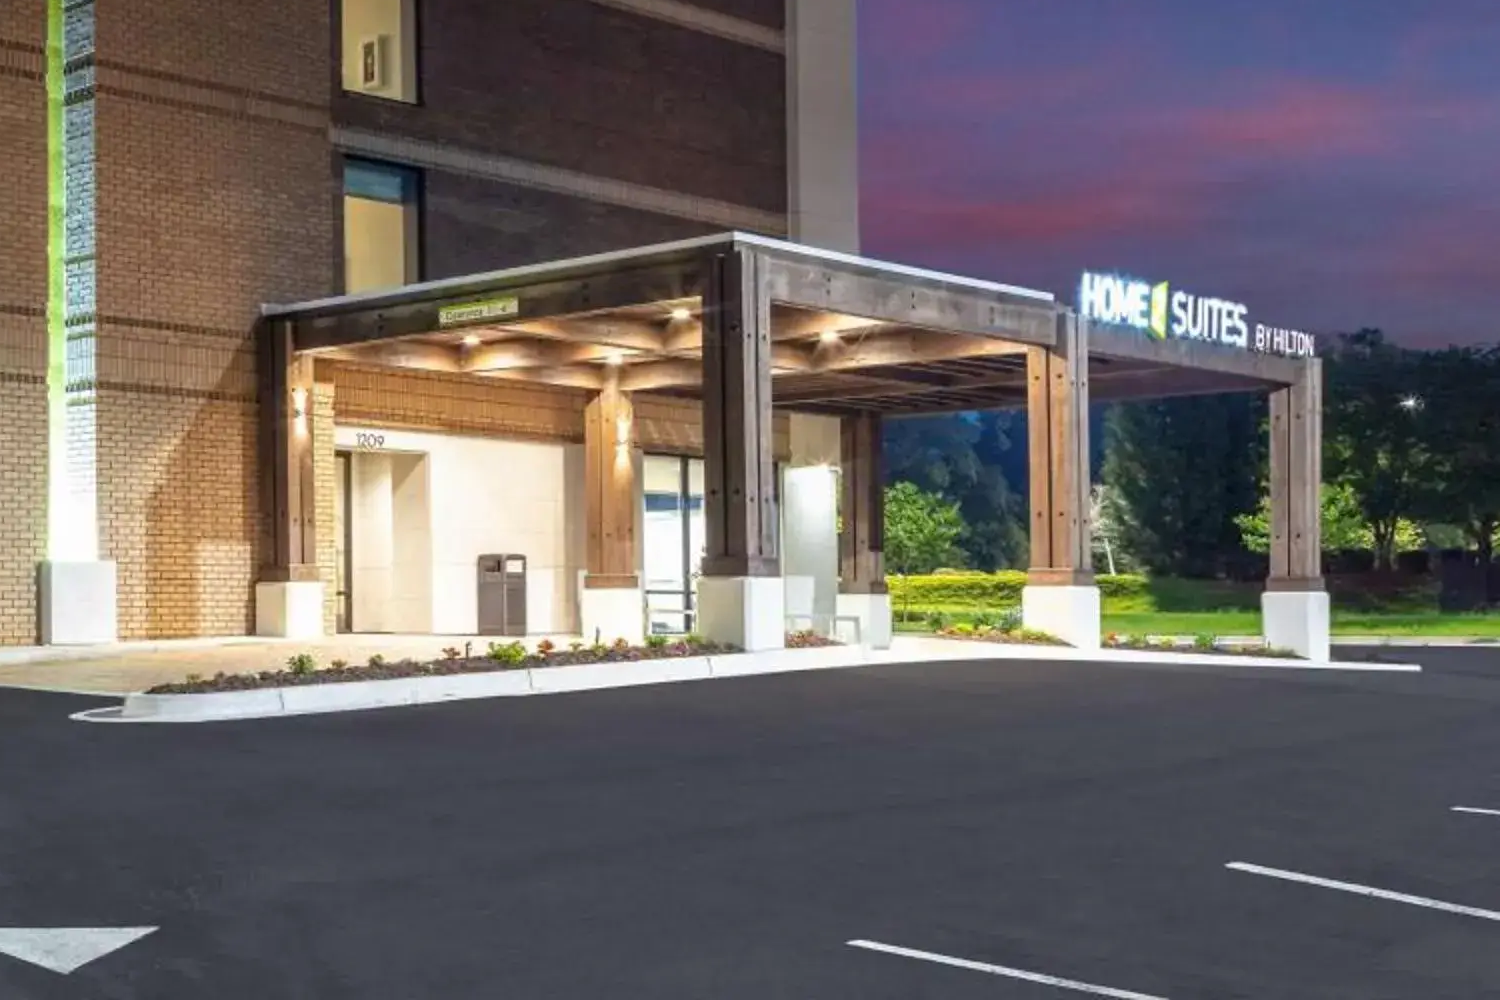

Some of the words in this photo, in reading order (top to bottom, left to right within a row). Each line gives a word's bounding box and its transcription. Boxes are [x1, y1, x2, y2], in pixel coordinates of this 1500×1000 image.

[1081, 271, 1149, 328] HOME
[1172, 290, 1248, 348] SUITES
[1255, 323, 1272, 349] BY
[1273, 328, 1315, 356] HILTON
[356, 432, 385, 449] 1209
